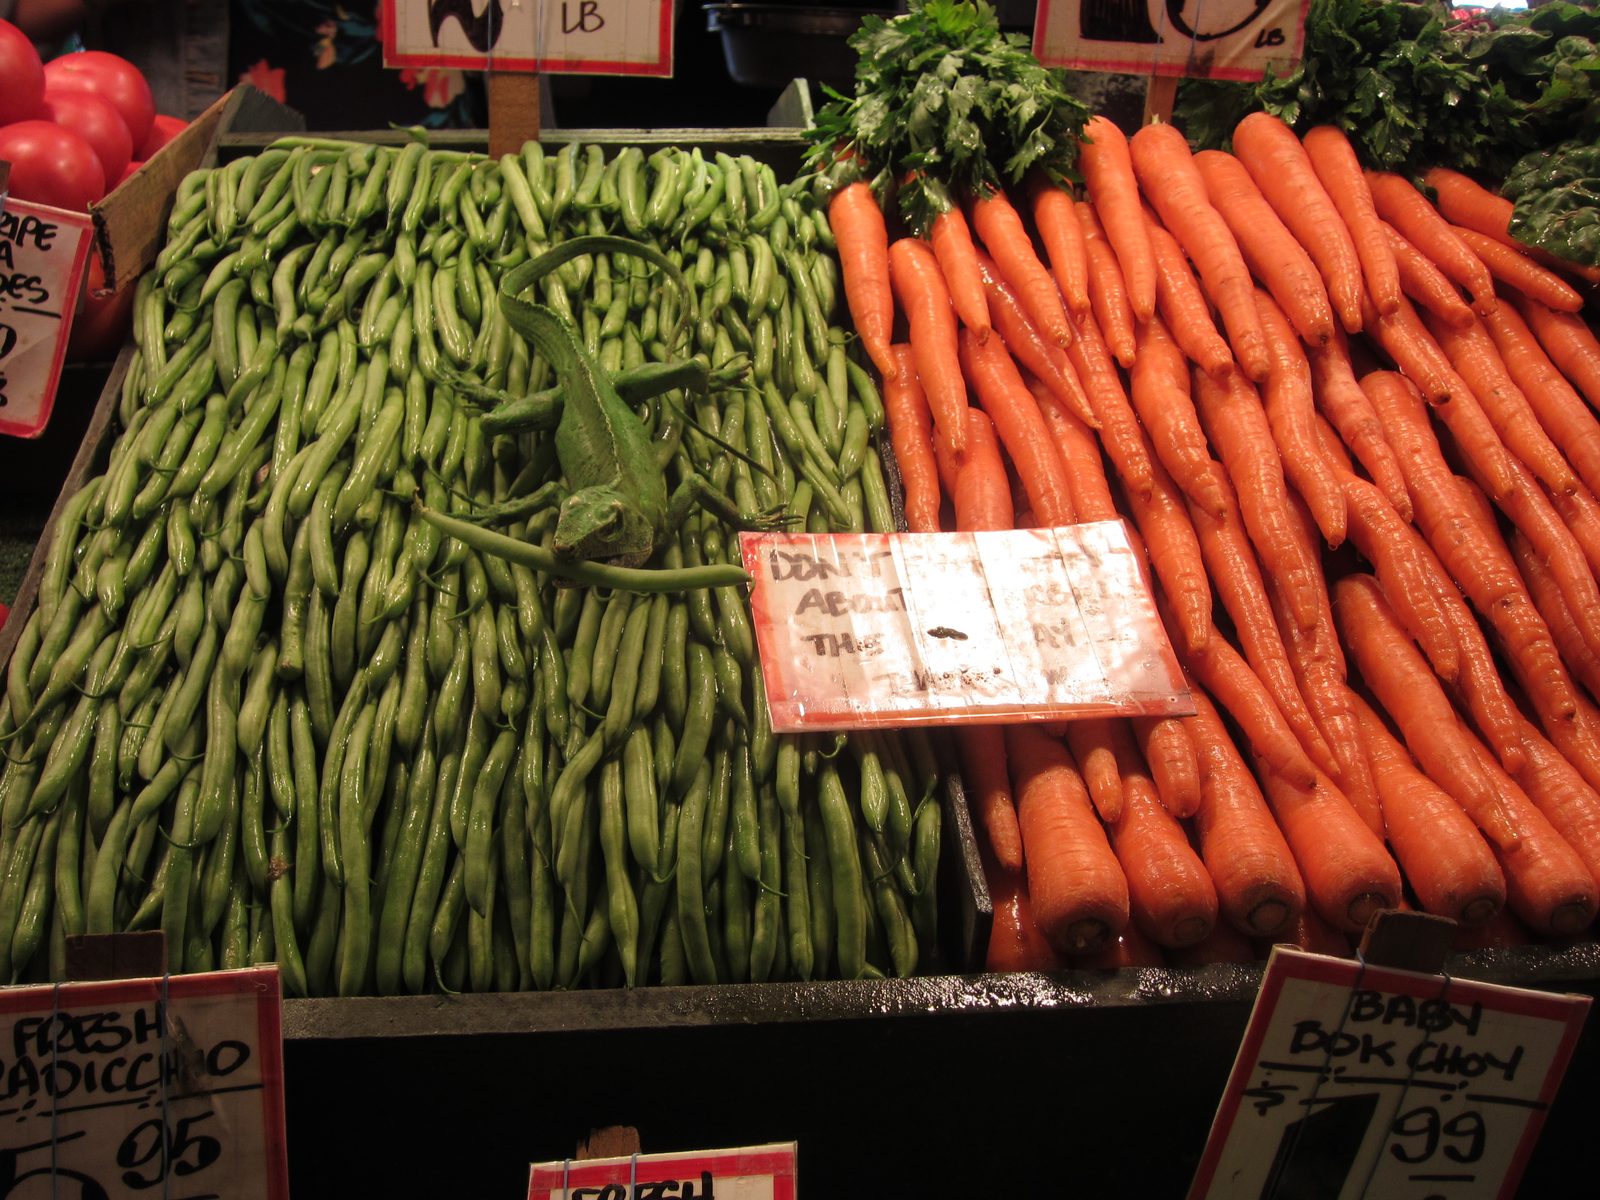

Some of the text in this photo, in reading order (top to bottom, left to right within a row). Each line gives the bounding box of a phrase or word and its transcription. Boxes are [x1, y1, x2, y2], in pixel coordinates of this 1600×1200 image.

[562, 1, 605, 34] LB
[1254, 28, 1285, 48] LB
[769, 549, 892, 581] DON'T
[14, 1002, 168, 1059] FRESH
[1351, 990, 1482, 1035] BABY
[1290, 1020, 1524, 1081] BOK CHOY
[116, 1110, 222, 1190] 95
[1390, 1106, 1486, 1164] 99
